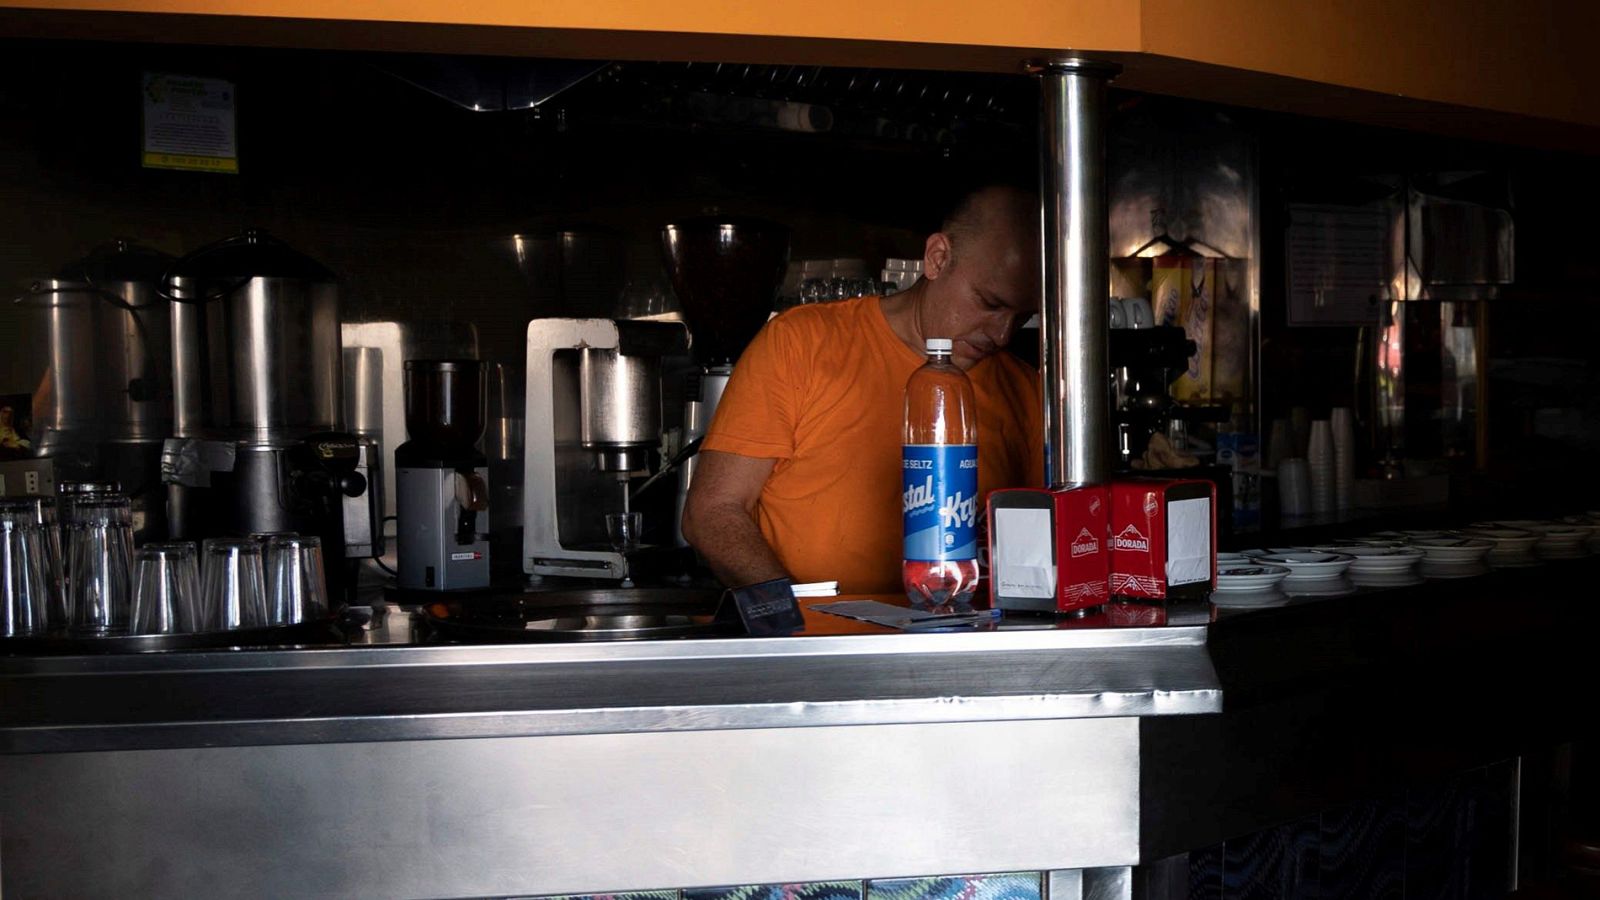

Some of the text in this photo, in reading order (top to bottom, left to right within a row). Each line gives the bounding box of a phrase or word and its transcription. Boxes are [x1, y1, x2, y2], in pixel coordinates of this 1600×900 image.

[910, 460, 933, 470] SELTZ
[1073, 541, 1097, 555] DORADA
[1117, 538, 1147, 550] DORADA
